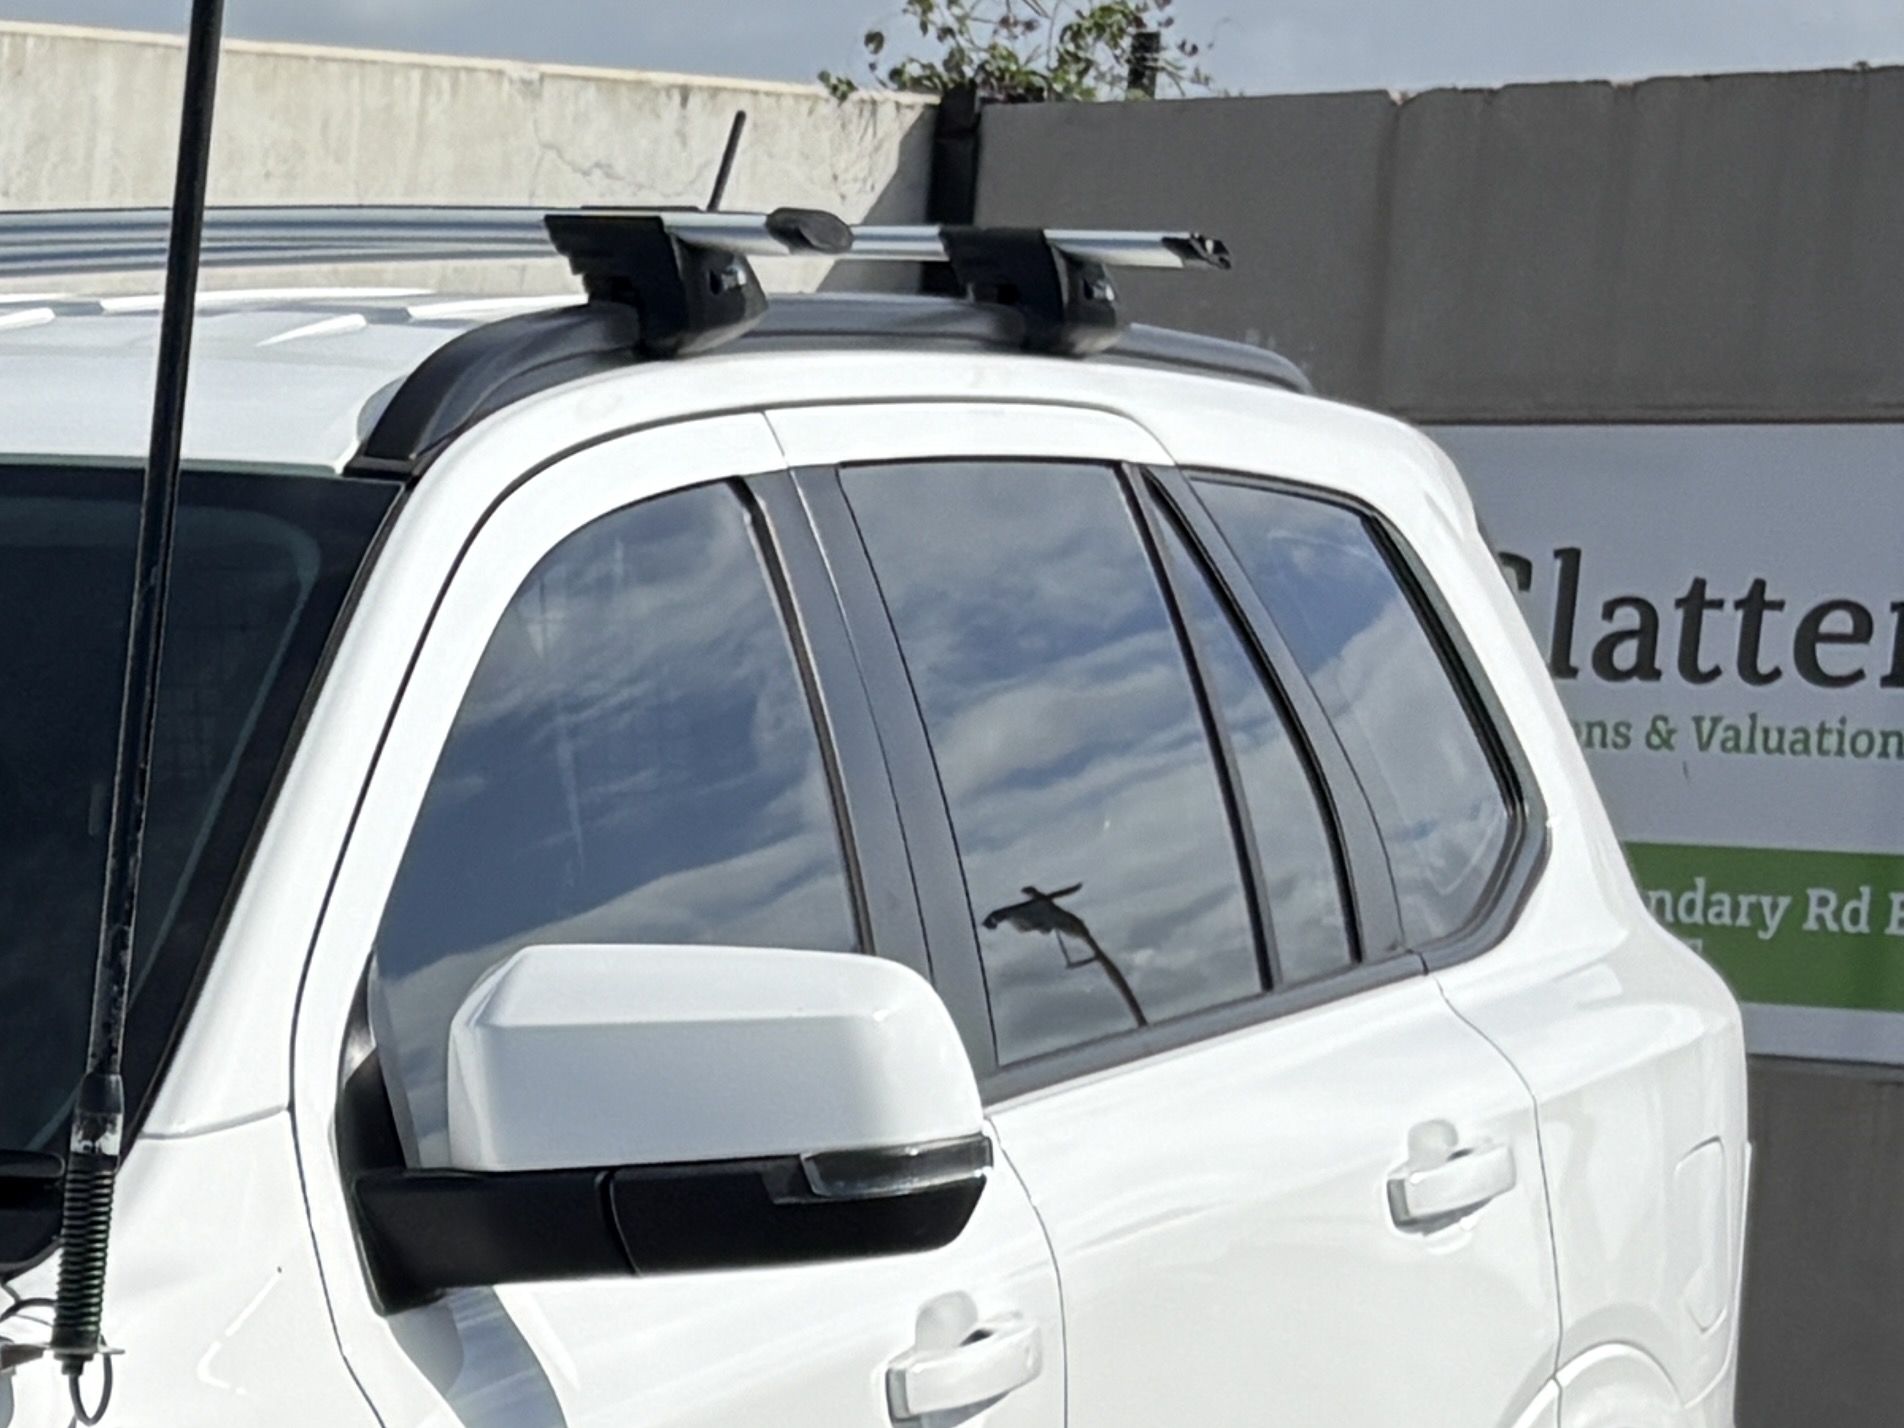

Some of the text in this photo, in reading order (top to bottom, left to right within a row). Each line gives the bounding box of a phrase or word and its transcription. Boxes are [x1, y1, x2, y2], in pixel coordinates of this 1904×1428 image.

[1496, 546, 1904, 688] latte
[1644, 713, 1679, 751] &
[1691, 711, 1904, 760] Valuation
[1801, 886, 1872, 935] Rd
